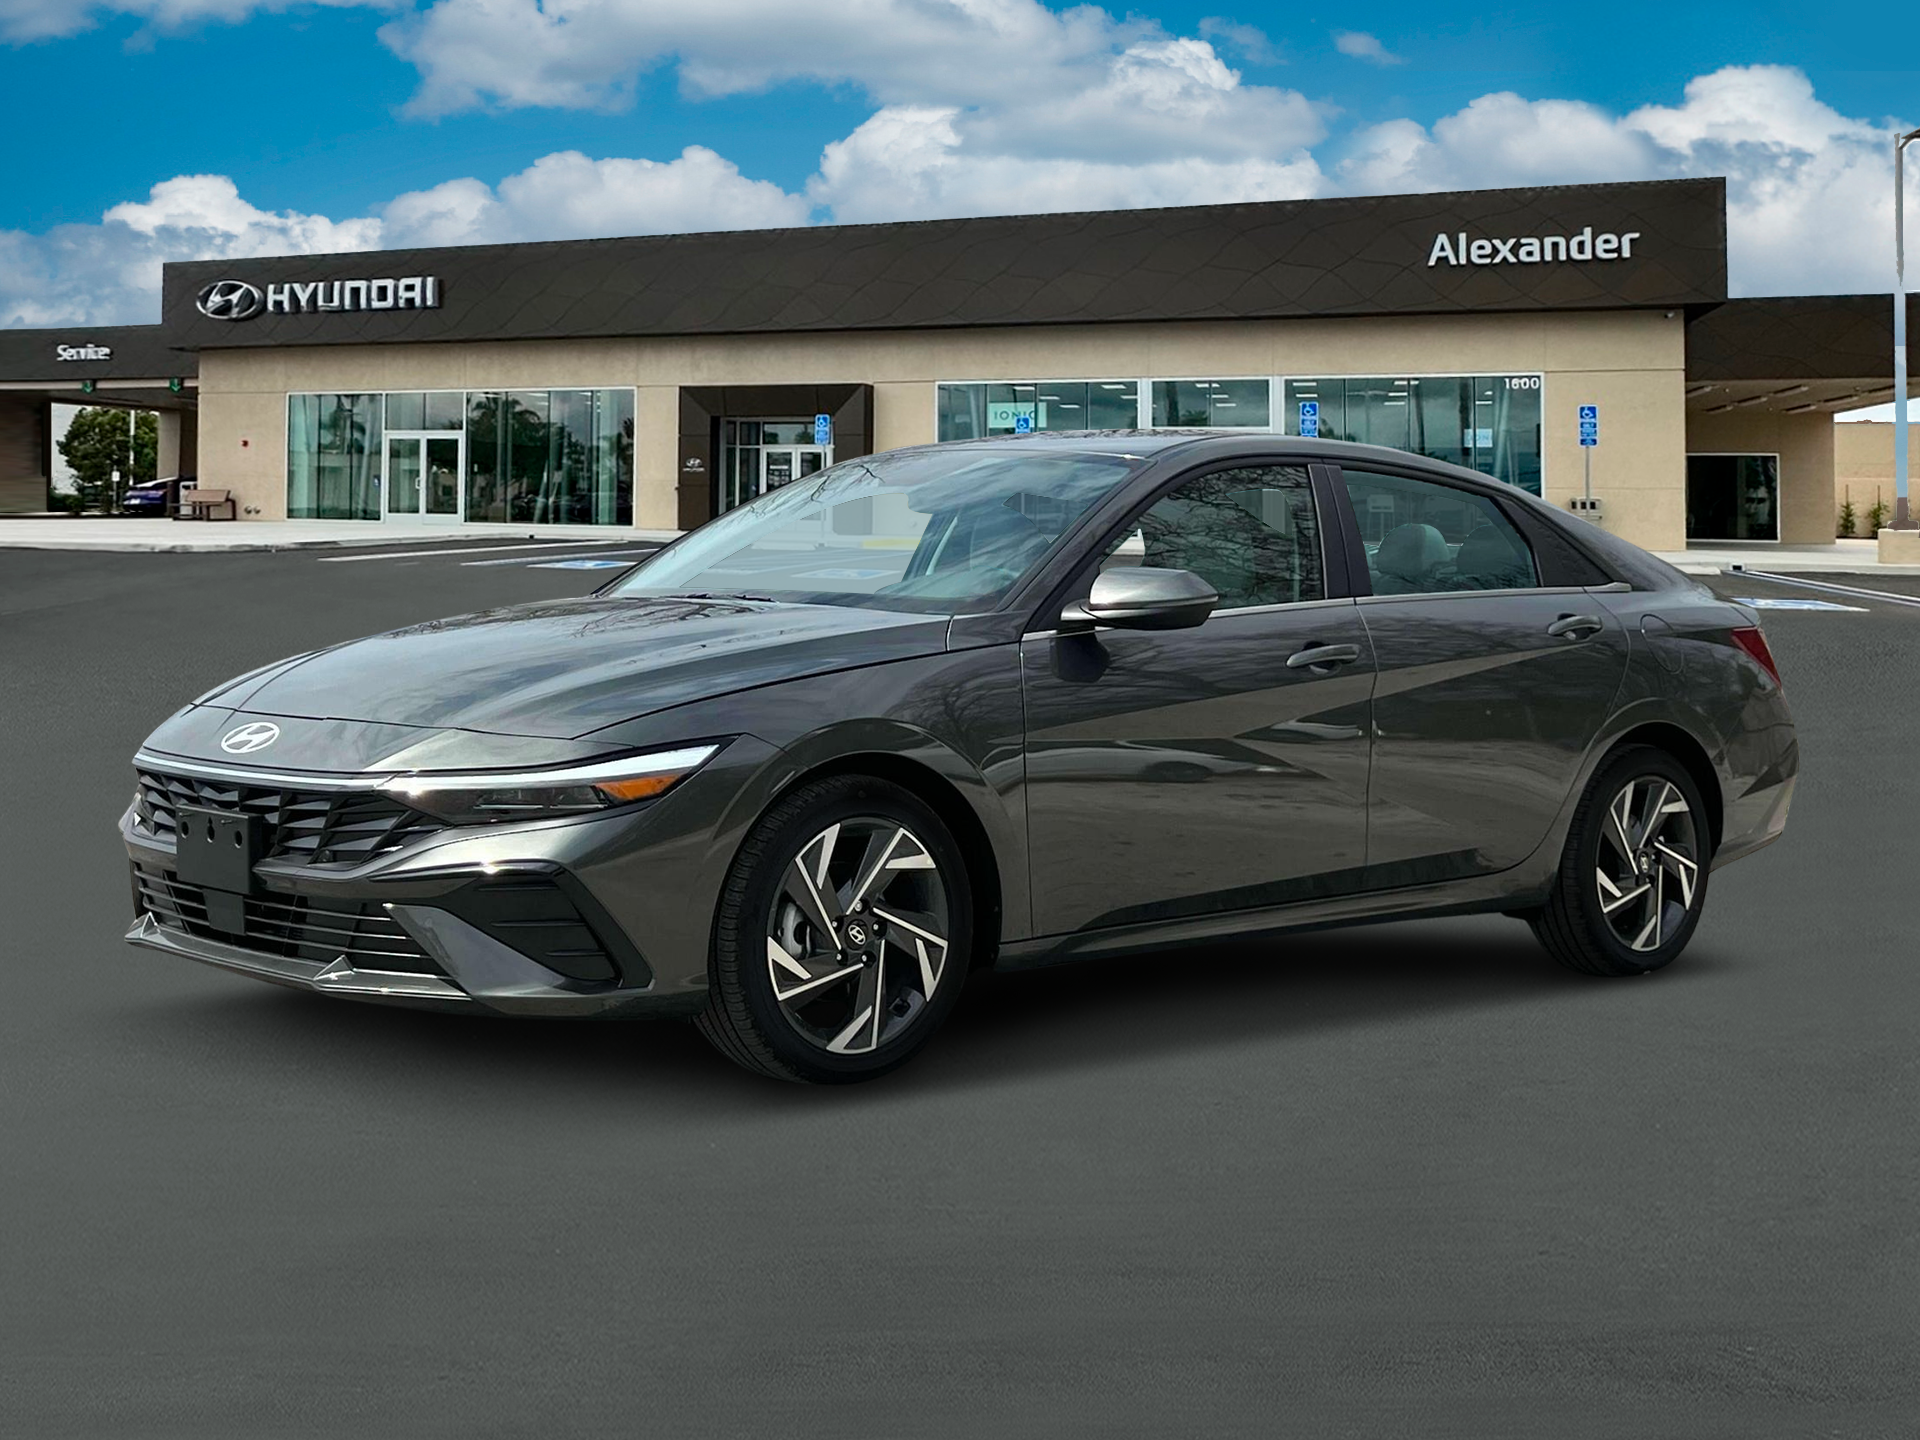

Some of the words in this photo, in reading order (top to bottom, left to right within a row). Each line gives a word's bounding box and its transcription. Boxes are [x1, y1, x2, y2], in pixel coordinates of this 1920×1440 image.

[1427, 226, 1640, 267] Alexander
[267, 276, 437, 313] HYUNDAI
[56, 343, 111, 361] Service
[1504, 377, 1540, 390] 1600
